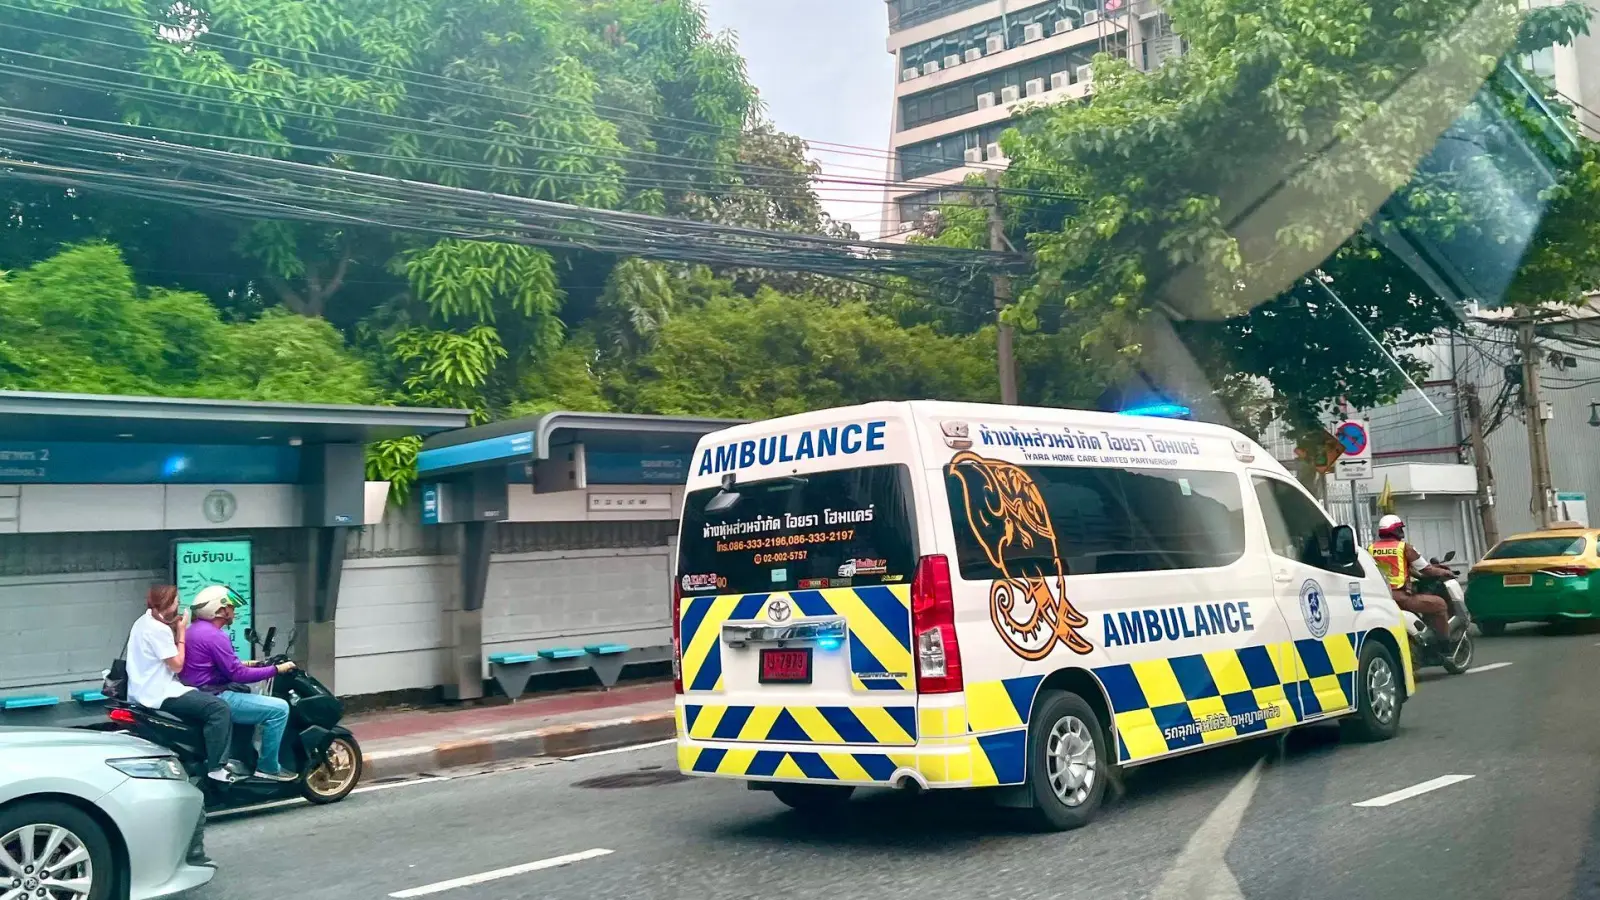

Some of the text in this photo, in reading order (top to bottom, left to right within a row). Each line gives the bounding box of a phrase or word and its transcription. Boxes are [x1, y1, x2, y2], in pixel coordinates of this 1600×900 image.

[698, 421, 886, 476] AMBULANCE
[979, 424, 1200, 455] ห้างหุ้นส่วนจำกัด ไอยรา โฮมแคร์
[1025, 453, 1178, 466] IYARA HOME CARE LIMITED PARTNERSHIP
[703, 504, 875, 540] ห้างหุ้นส่วนจำกัด ไอยรา โฮมแคร์
[763, 551, 808, 562] 02-002-5757
[1103, 602, 1254, 647] AMBULANCE
